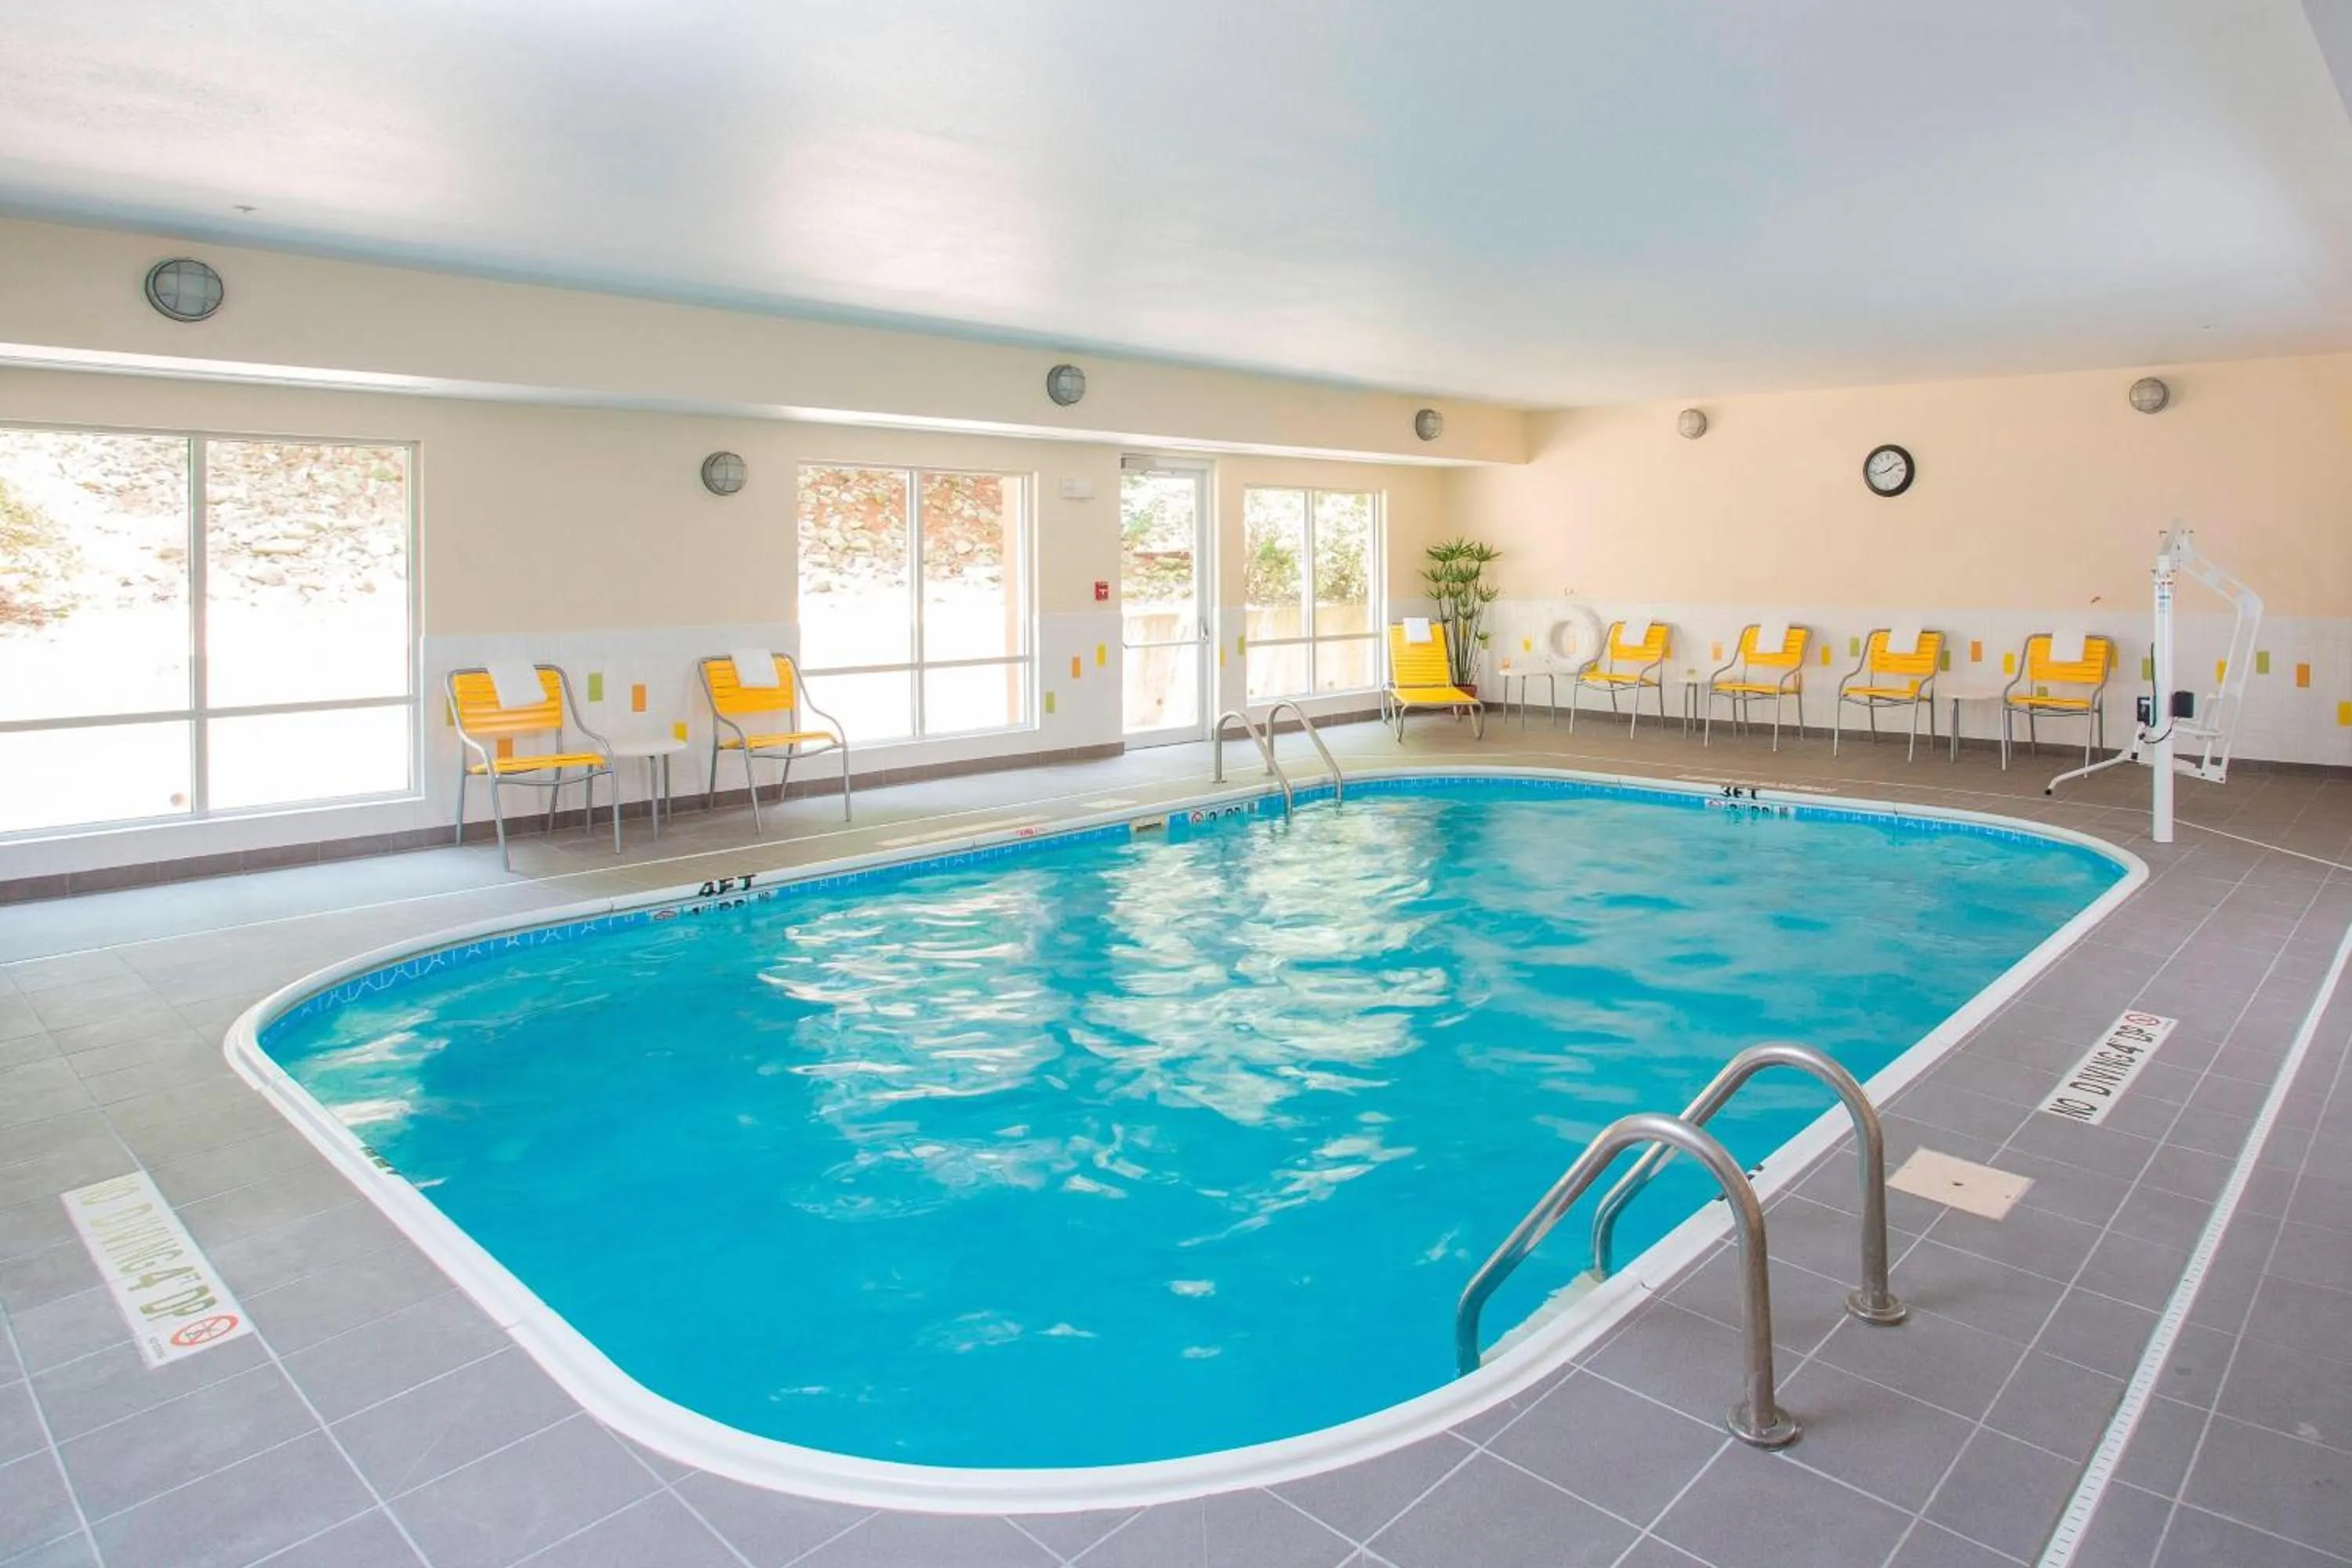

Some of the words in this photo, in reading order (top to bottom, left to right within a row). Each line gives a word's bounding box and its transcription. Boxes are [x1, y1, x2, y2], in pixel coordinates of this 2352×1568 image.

[2069, 1051, 2136, 1097] DIVING
[2048, 1098, 2098, 1120] NO
[90, 1203, 184, 1272] DIVING
[139, 1285, 217, 1323] DP
